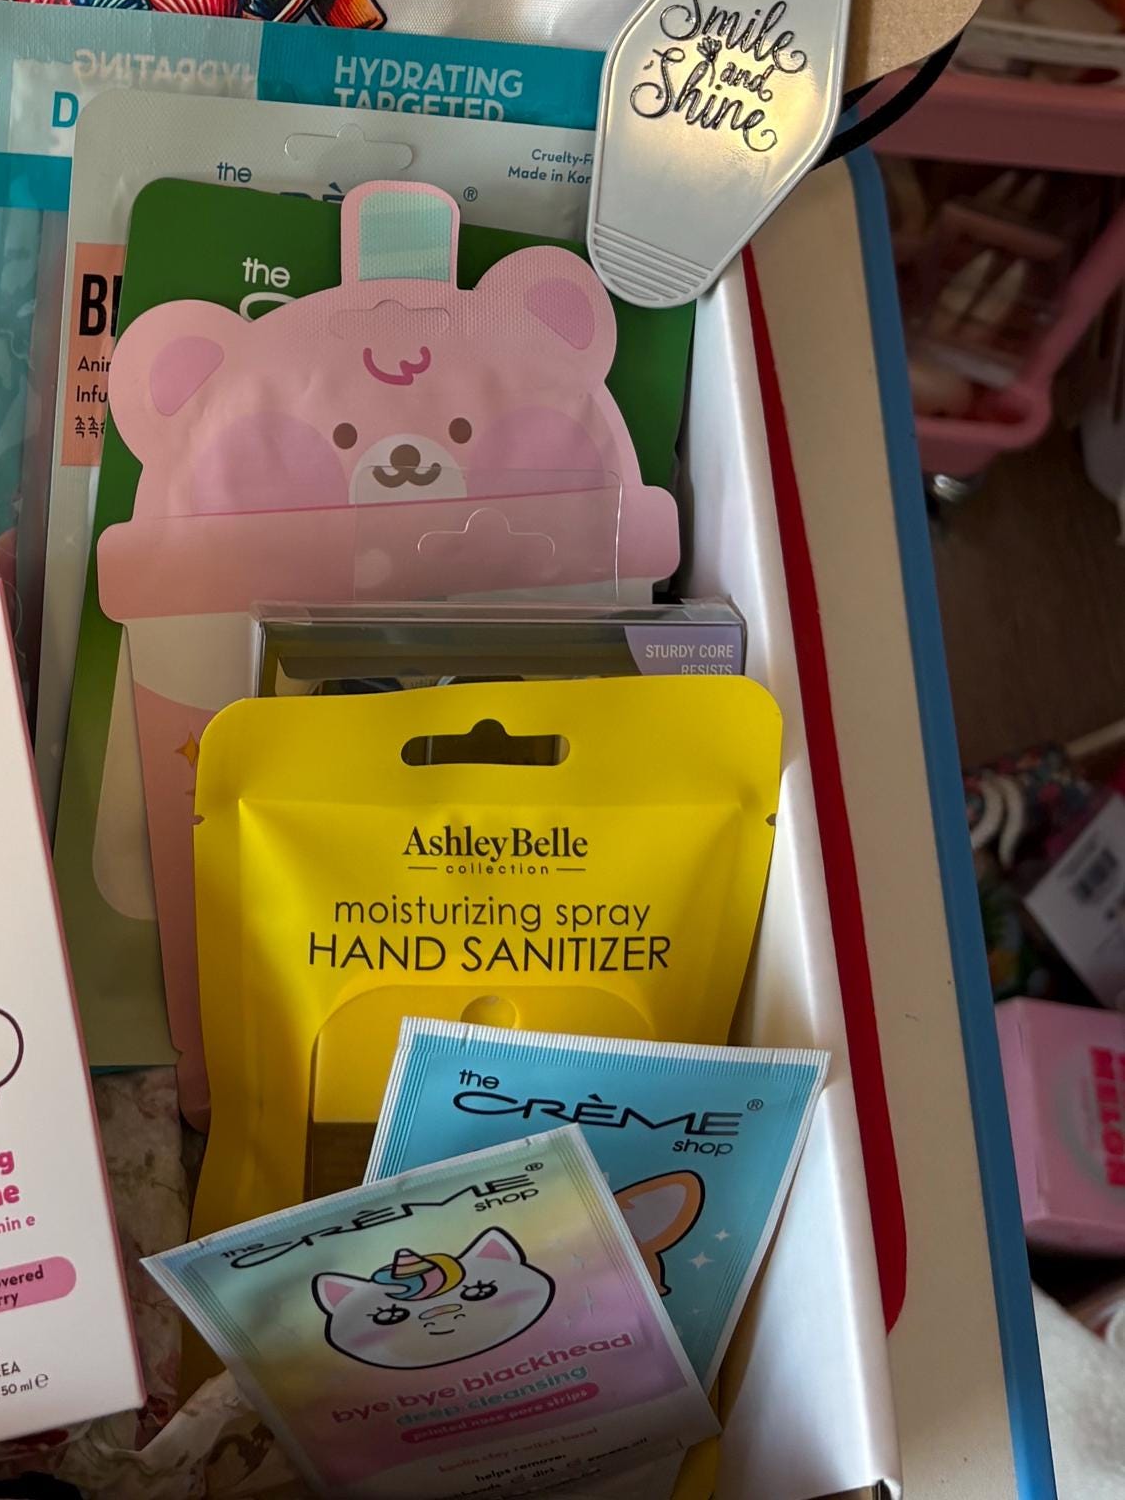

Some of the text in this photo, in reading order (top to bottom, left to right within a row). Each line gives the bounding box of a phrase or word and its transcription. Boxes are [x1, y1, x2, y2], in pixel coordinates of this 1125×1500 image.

[333, 55, 524, 100] HYDRATING
[719, 62, 776, 103] and
[333, 87, 506, 122] TARGETED
[630, 47, 778, 153] Shine
[216, 161, 253, 183] the
[507, 165, 548, 182] Made
[550, 167, 562, 183] in
[241, 256, 291, 289] the
[645, 644, 735, 659] STURDY CORE
[445, 862, 549, 876] collection
[334, 894, 651, 933] moisturizing spray
[309, 931, 671, 973] HAND SANITIZER
[458, 1068, 500, 1090] the
[453, 1093, 743, 1137] CRÈME
[672, 1137, 735, 1158] shop
[474, 1186, 540, 1213] shop
[25, 1214, 37, 1228] e
[229, 1172, 535, 1269] CRÈME
[220, 1242, 266, 1260] the
[1, 1383, 18, 1397] 50
[19, 1378, 34, 1393] ml
[331, 1333, 633, 1423] bye bye blackhead
[467, 1365, 588, 1410] cleansing
